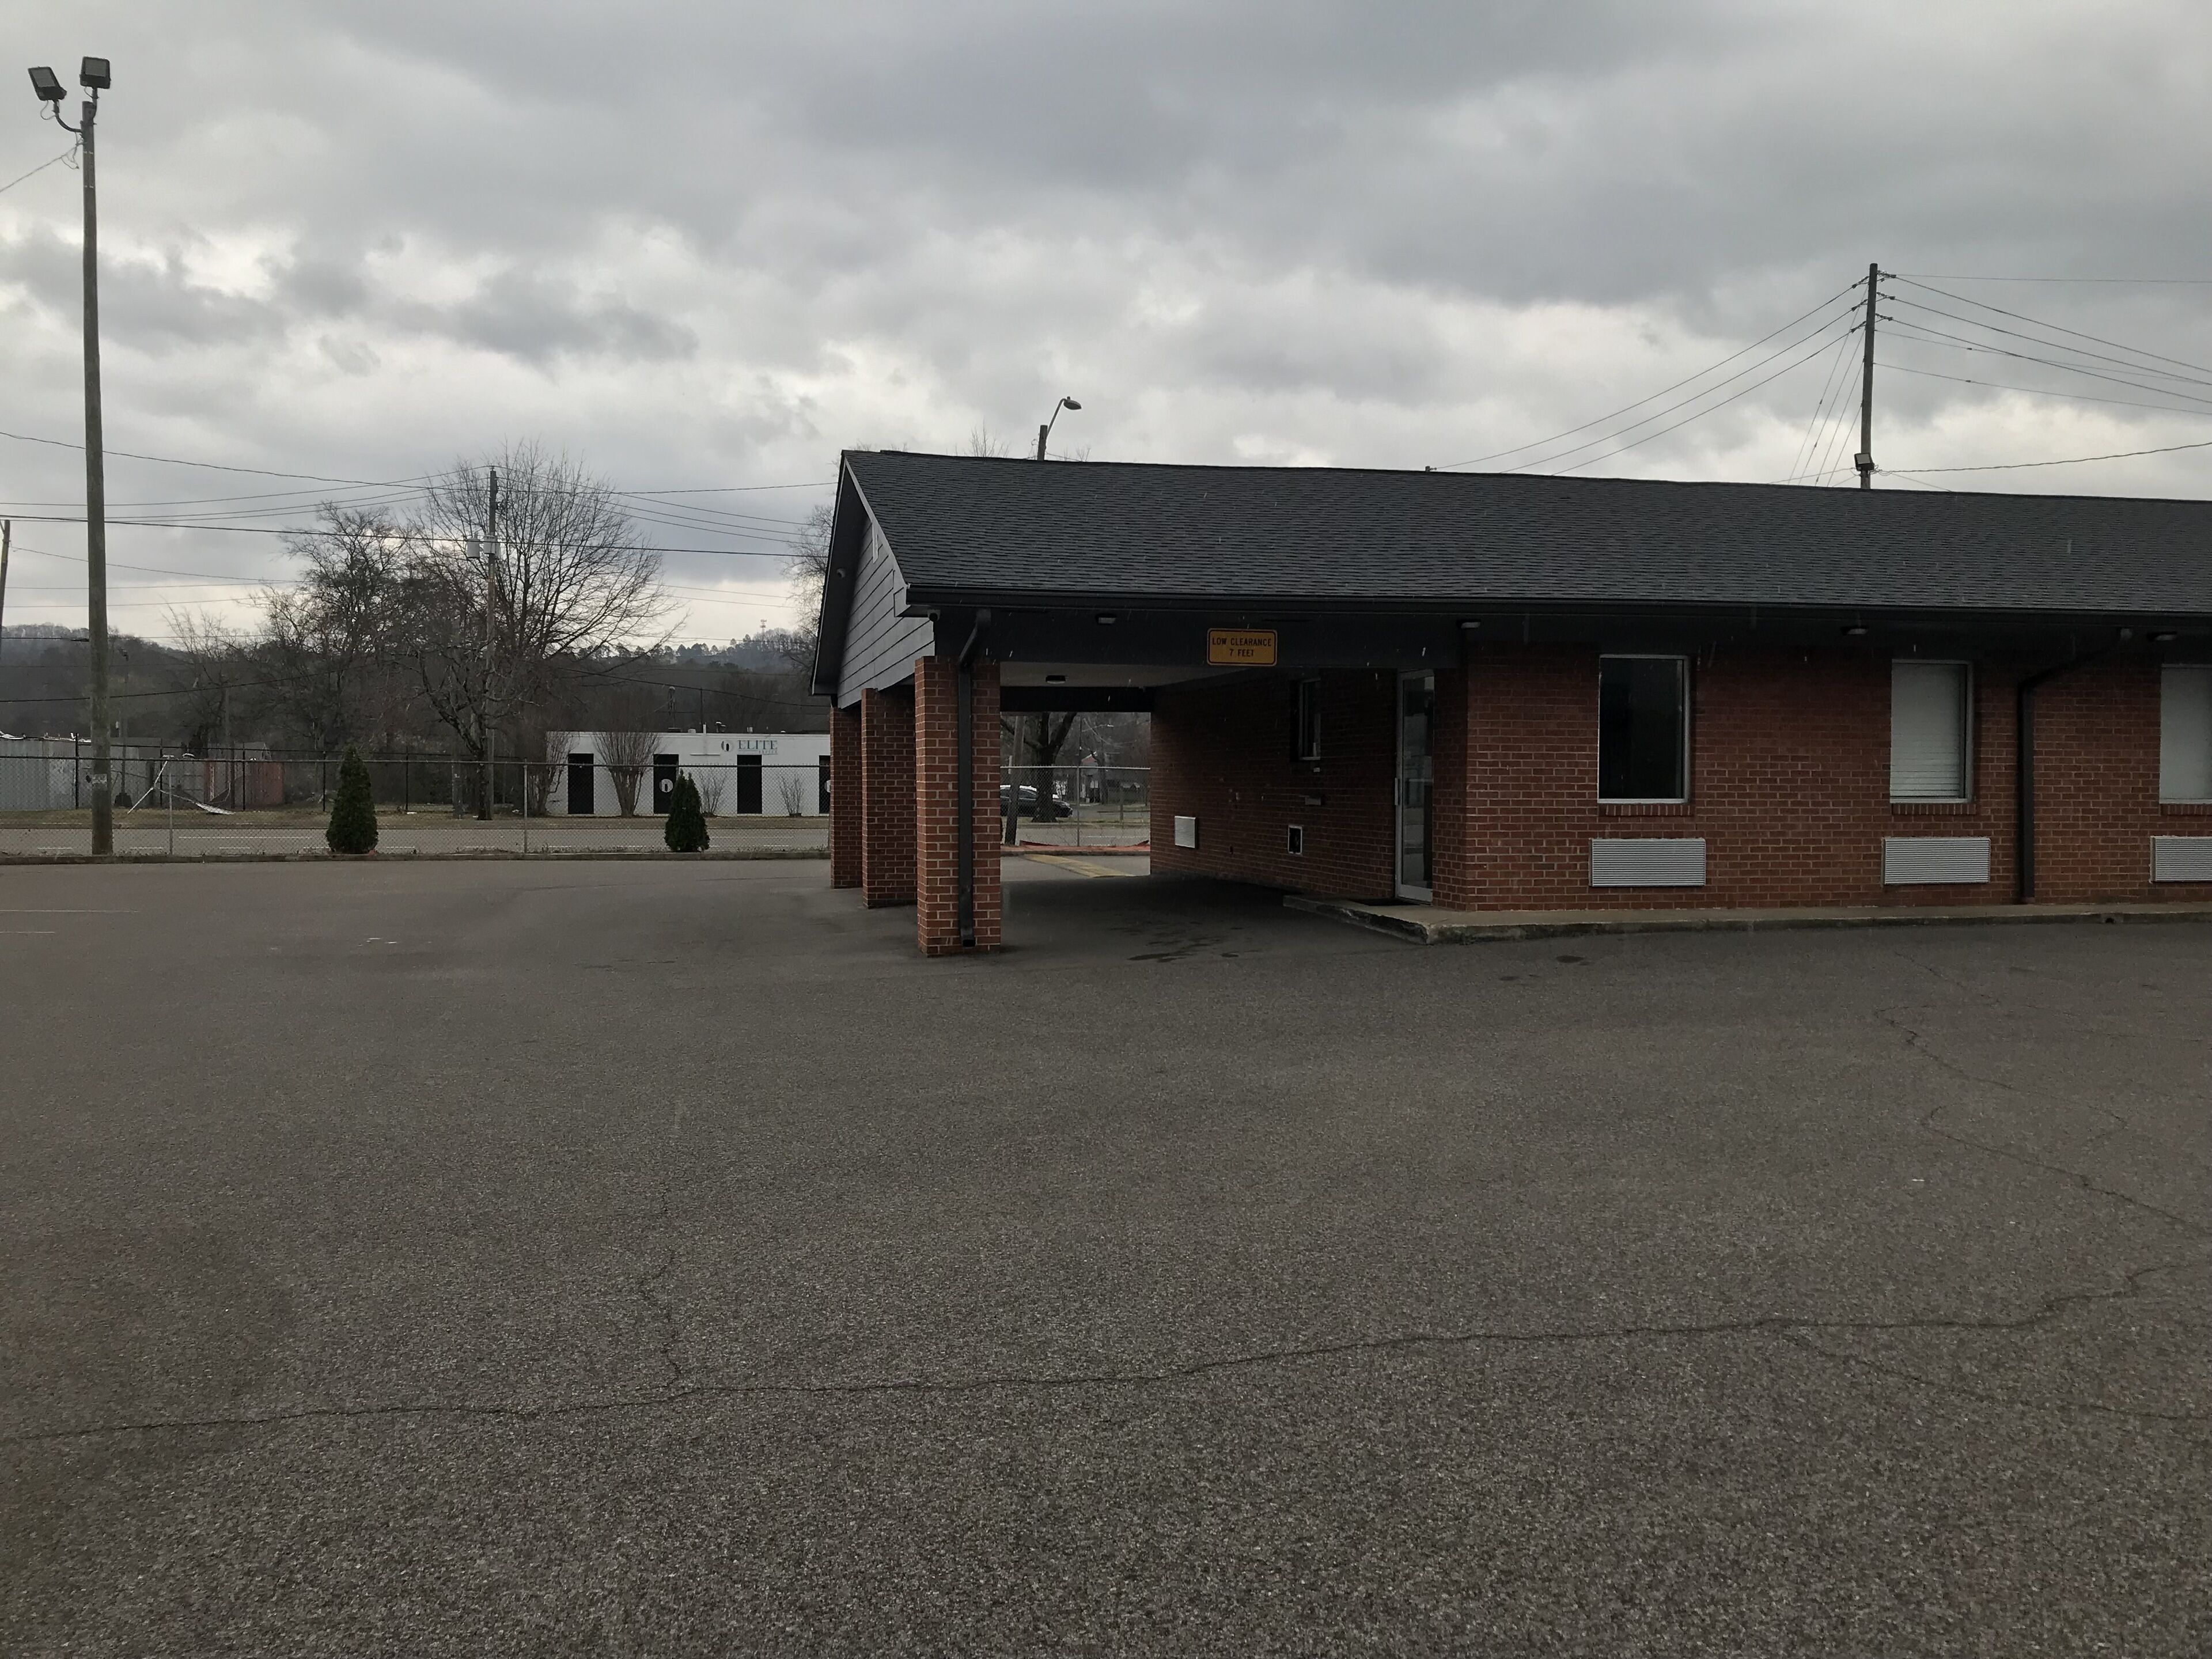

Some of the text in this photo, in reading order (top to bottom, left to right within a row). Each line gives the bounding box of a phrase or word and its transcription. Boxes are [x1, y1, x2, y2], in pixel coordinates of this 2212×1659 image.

[1212, 637, 1272, 646] LOW CLEARANCE
[1237, 649, 1254, 657] FEET
[737, 740, 778, 749] ELITE
